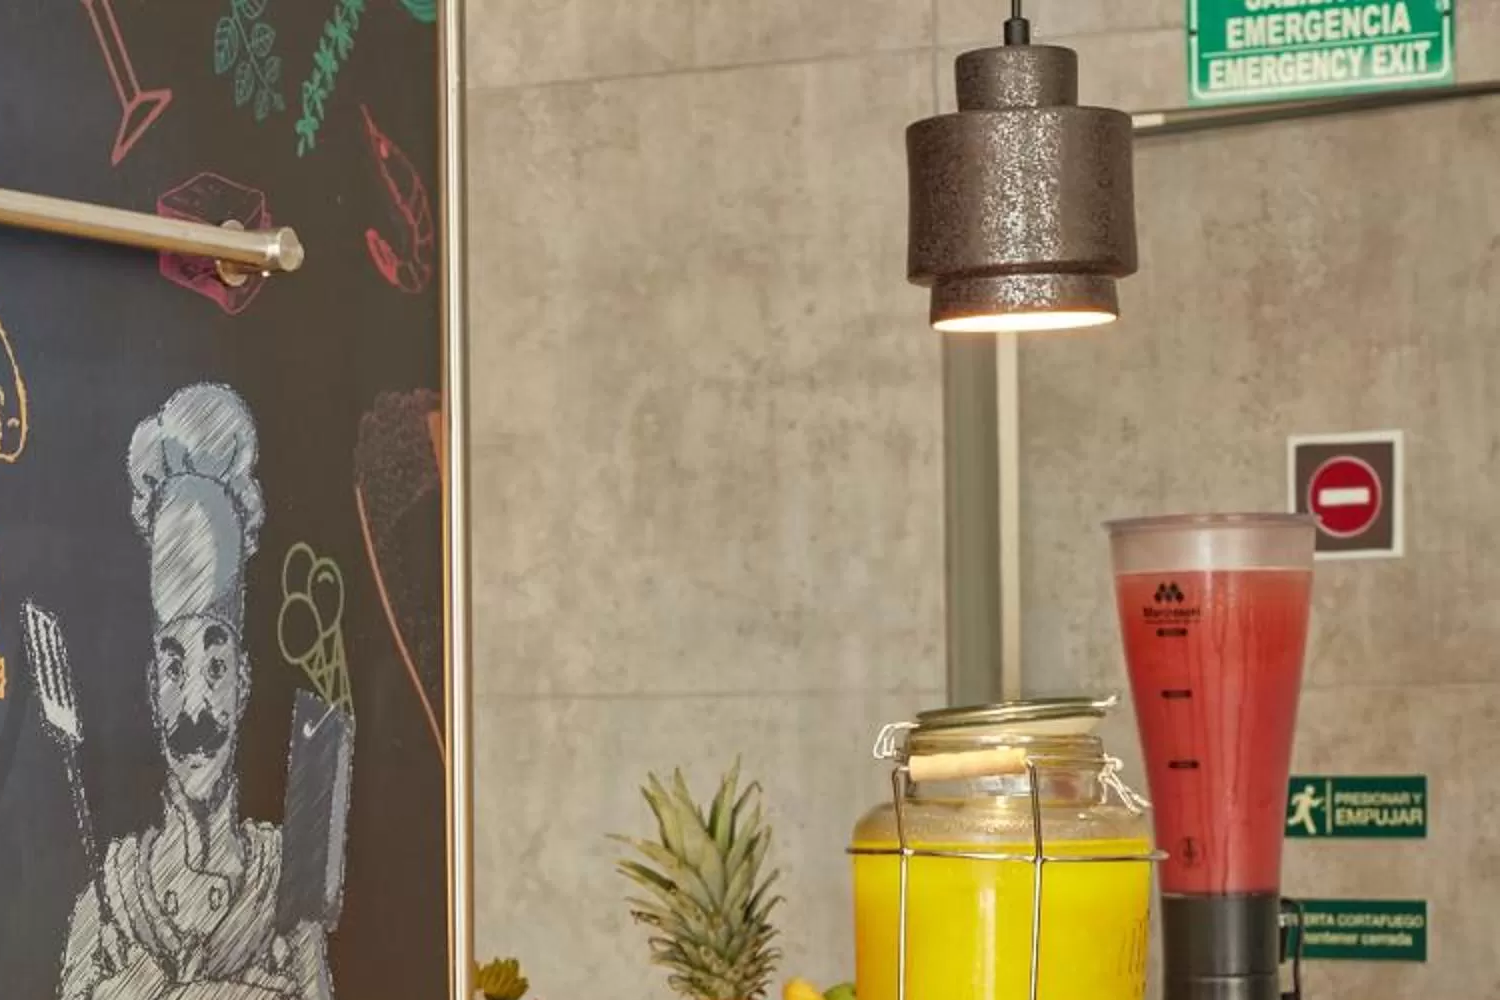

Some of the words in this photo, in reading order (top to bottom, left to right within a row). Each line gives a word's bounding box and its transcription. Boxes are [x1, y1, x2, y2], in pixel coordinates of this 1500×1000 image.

[1225, 2, 1412, 49] EMERGENCIA
[1207, 46, 1365, 90] EMERGENCY
[1371, 40, 1432, 76] EXIT
[1334, 807, 1424, 827] EMPUJAR
